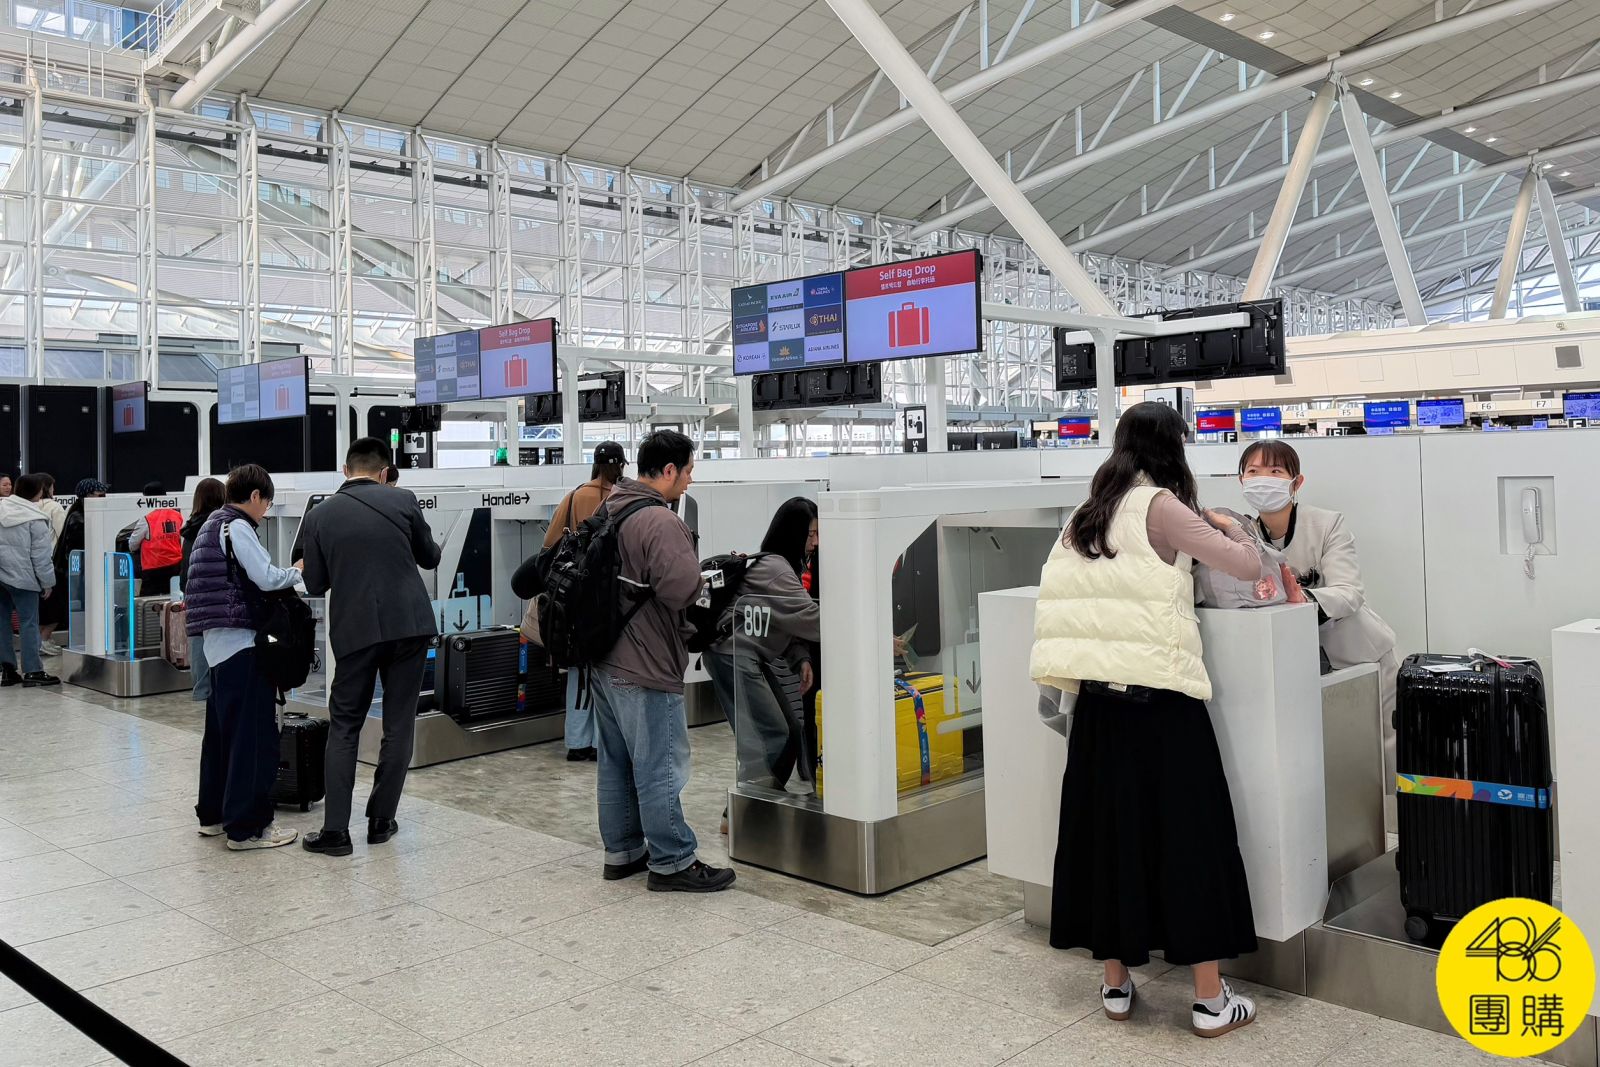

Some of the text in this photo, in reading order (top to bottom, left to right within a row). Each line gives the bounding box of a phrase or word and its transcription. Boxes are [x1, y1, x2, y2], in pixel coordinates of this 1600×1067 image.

[879, 264, 936, 281] Self Bag Drop
[819, 313, 838, 323] THAI
[498, 327, 531, 337] Self Bag Drop
[1481, 402, 1492, 410] F6
[1536, 400, 1547, 408] F7
[1227, 432, 1236, 443] F
[55, 496, 76, 505] andl
[146, 497, 178, 508] Wheel
[482, 493, 521, 506] Handle
[119, 559, 128, 577] 804
[744, 604, 771, 638] 807
